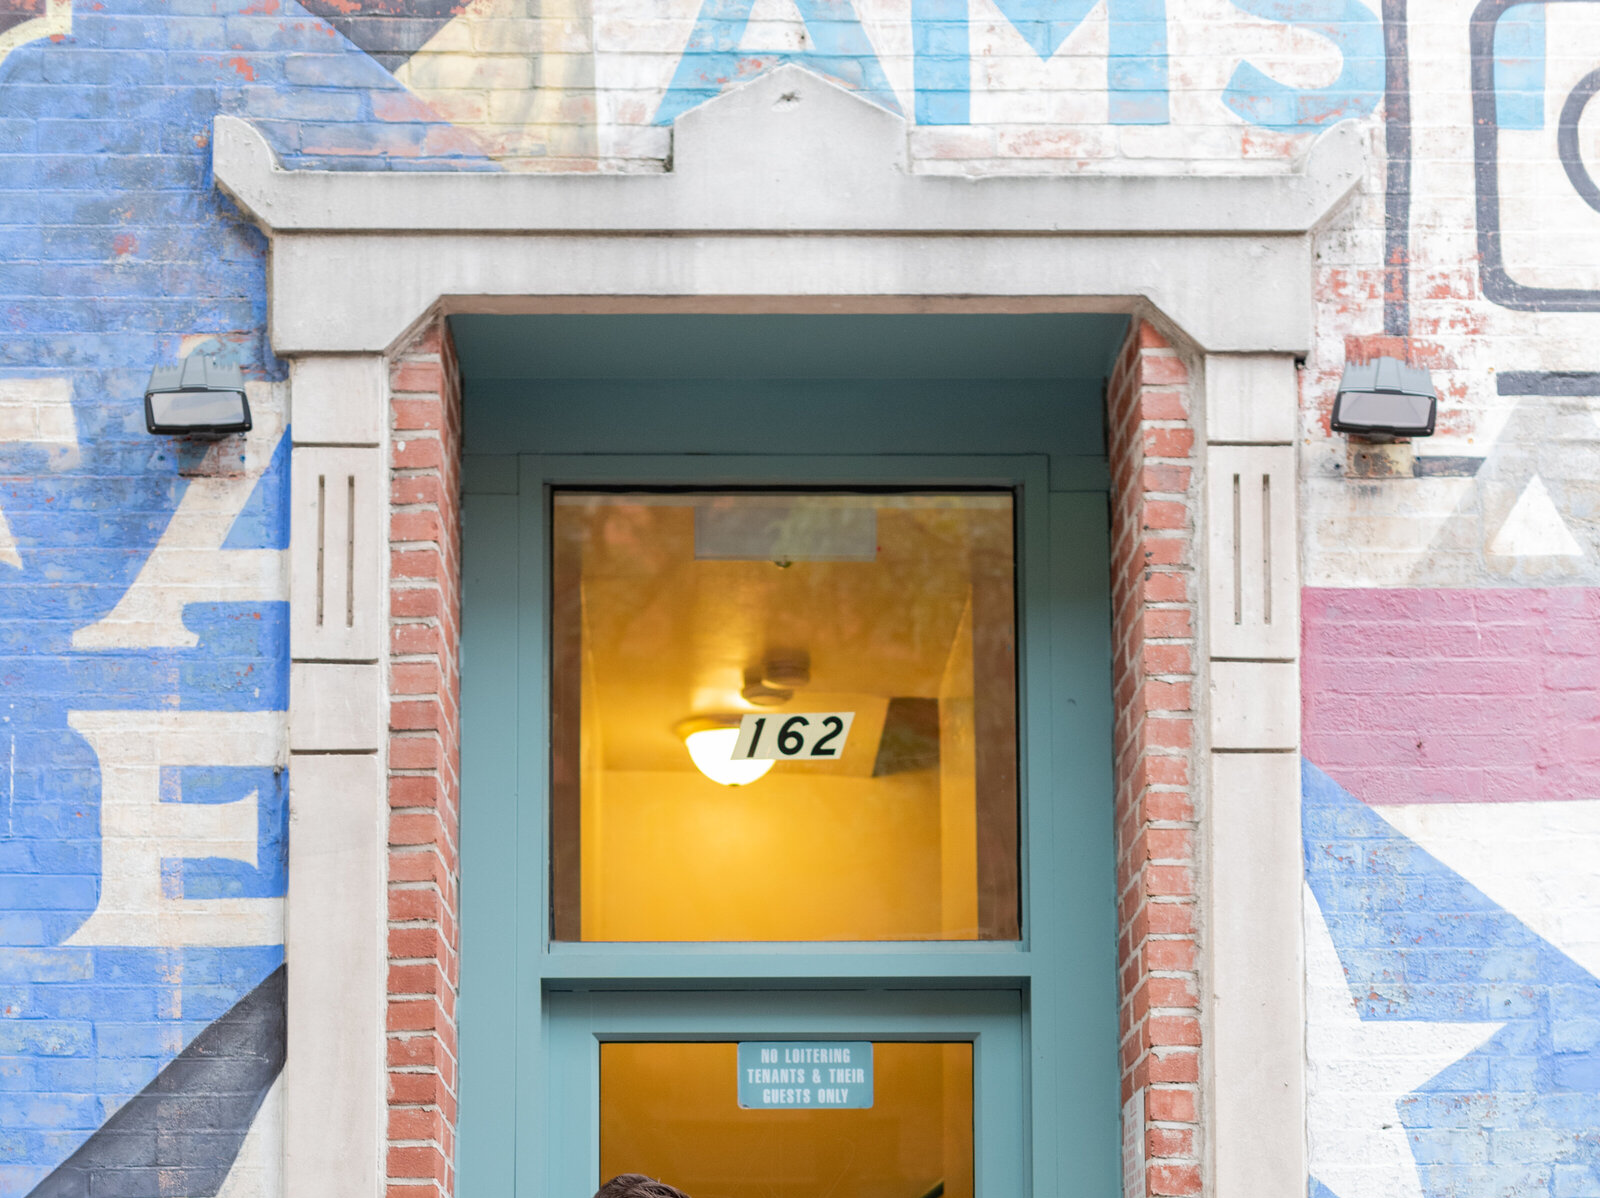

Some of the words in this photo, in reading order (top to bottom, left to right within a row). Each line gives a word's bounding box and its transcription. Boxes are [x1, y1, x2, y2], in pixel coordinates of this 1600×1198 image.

[747, 716, 844, 758] 162
[761, 1048, 778, 1064] NO
[785, 1048, 851, 1064] LOITERING
[747, 1068, 805, 1084] TENANTS
[812, 1068, 821, 1084] &
[829, 1068, 865, 1084] THEIR
[762, 1088, 811, 1104] GUESTS
[818, 1088, 849, 1104] ONLY
